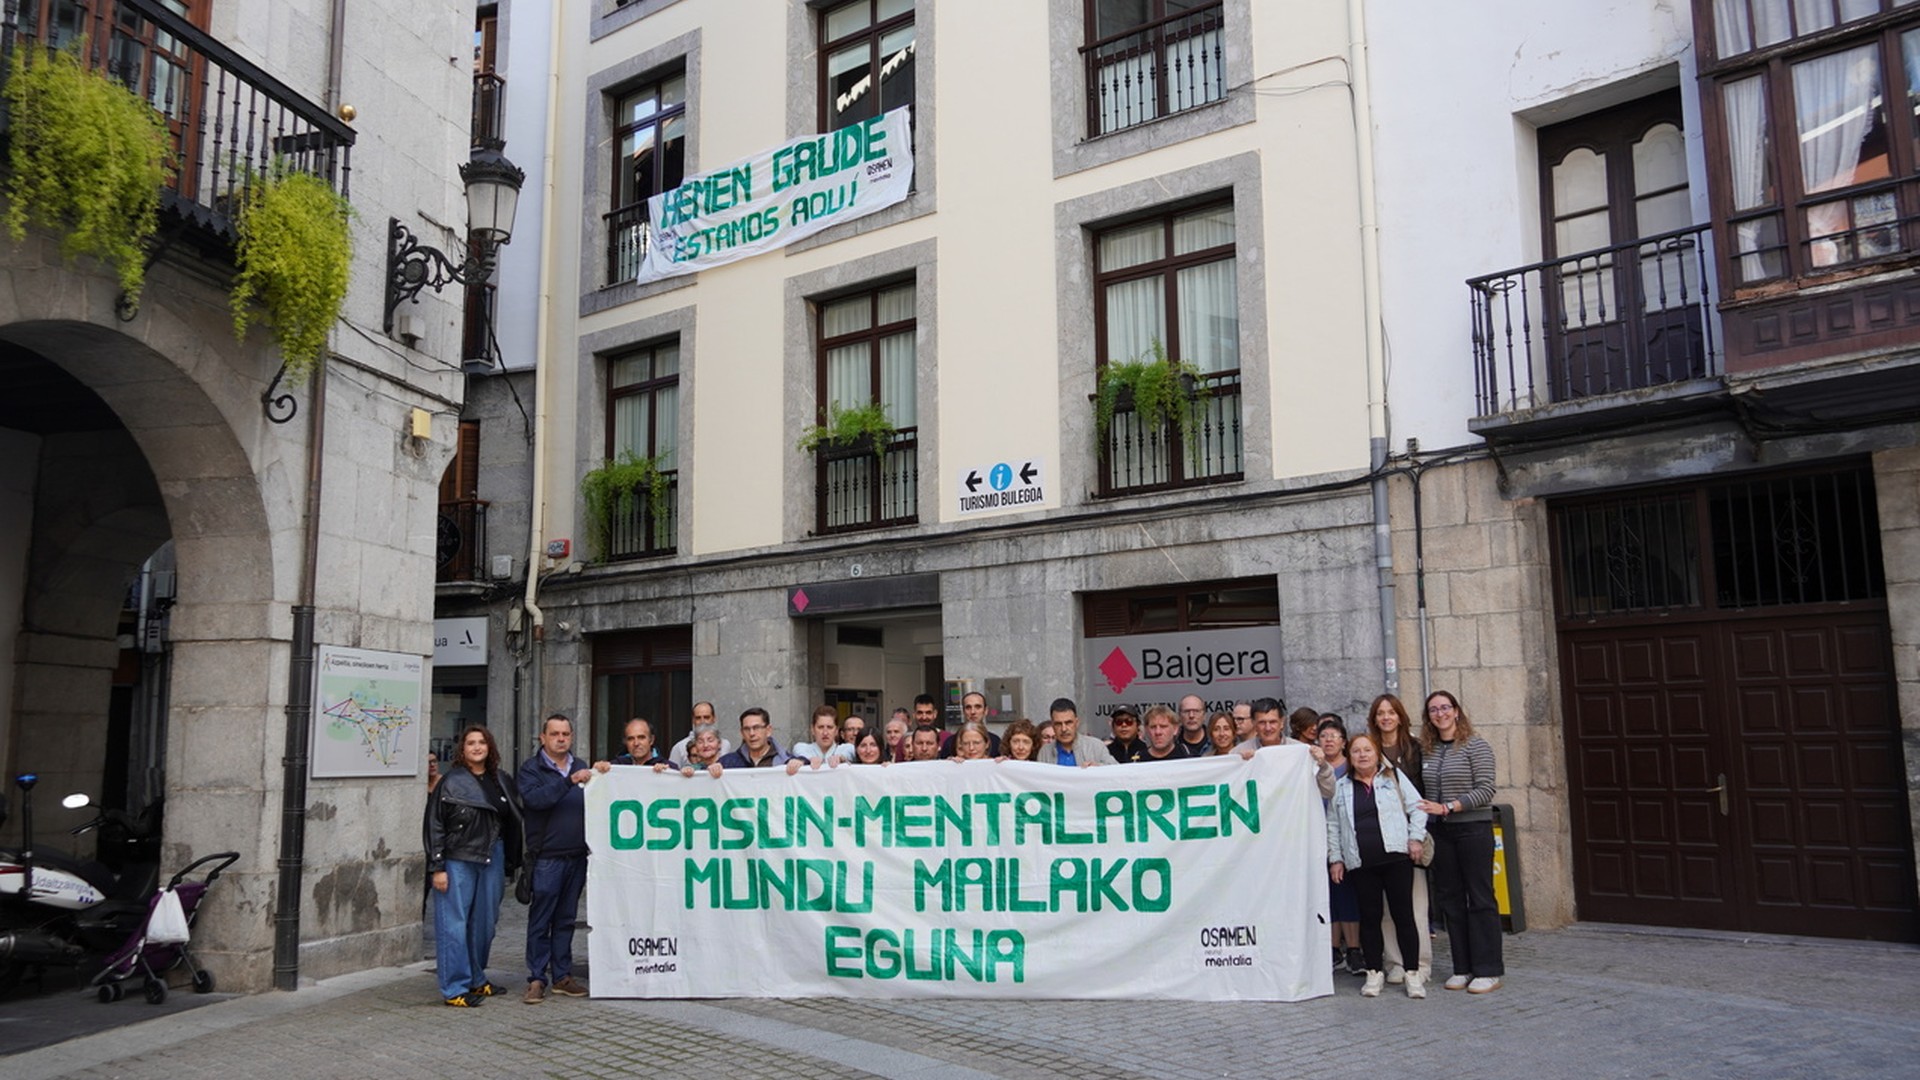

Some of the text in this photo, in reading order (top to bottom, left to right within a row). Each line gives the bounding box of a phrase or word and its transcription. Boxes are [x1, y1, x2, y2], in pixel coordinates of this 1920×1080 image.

[661, 114, 887, 229] HEMEN GAUDE
[673, 206, 779, 263] ESTAMOS
[960, 487, 1043, 511] TURISMO BULEGOA
[851, 564, 862, 577] 6
[1141, 646, 1270, 685] Baigera
[609, 780, 1260, 851] OSASUN-MENTALAREN
[685, 858, 1171, 914] MUNDU MAILAKO
[628, 937, 678, 956] OSAMEN
[825, 926, 1025, 984] EGUNA
[1200, 925, 1257, 947] OSAMEN
